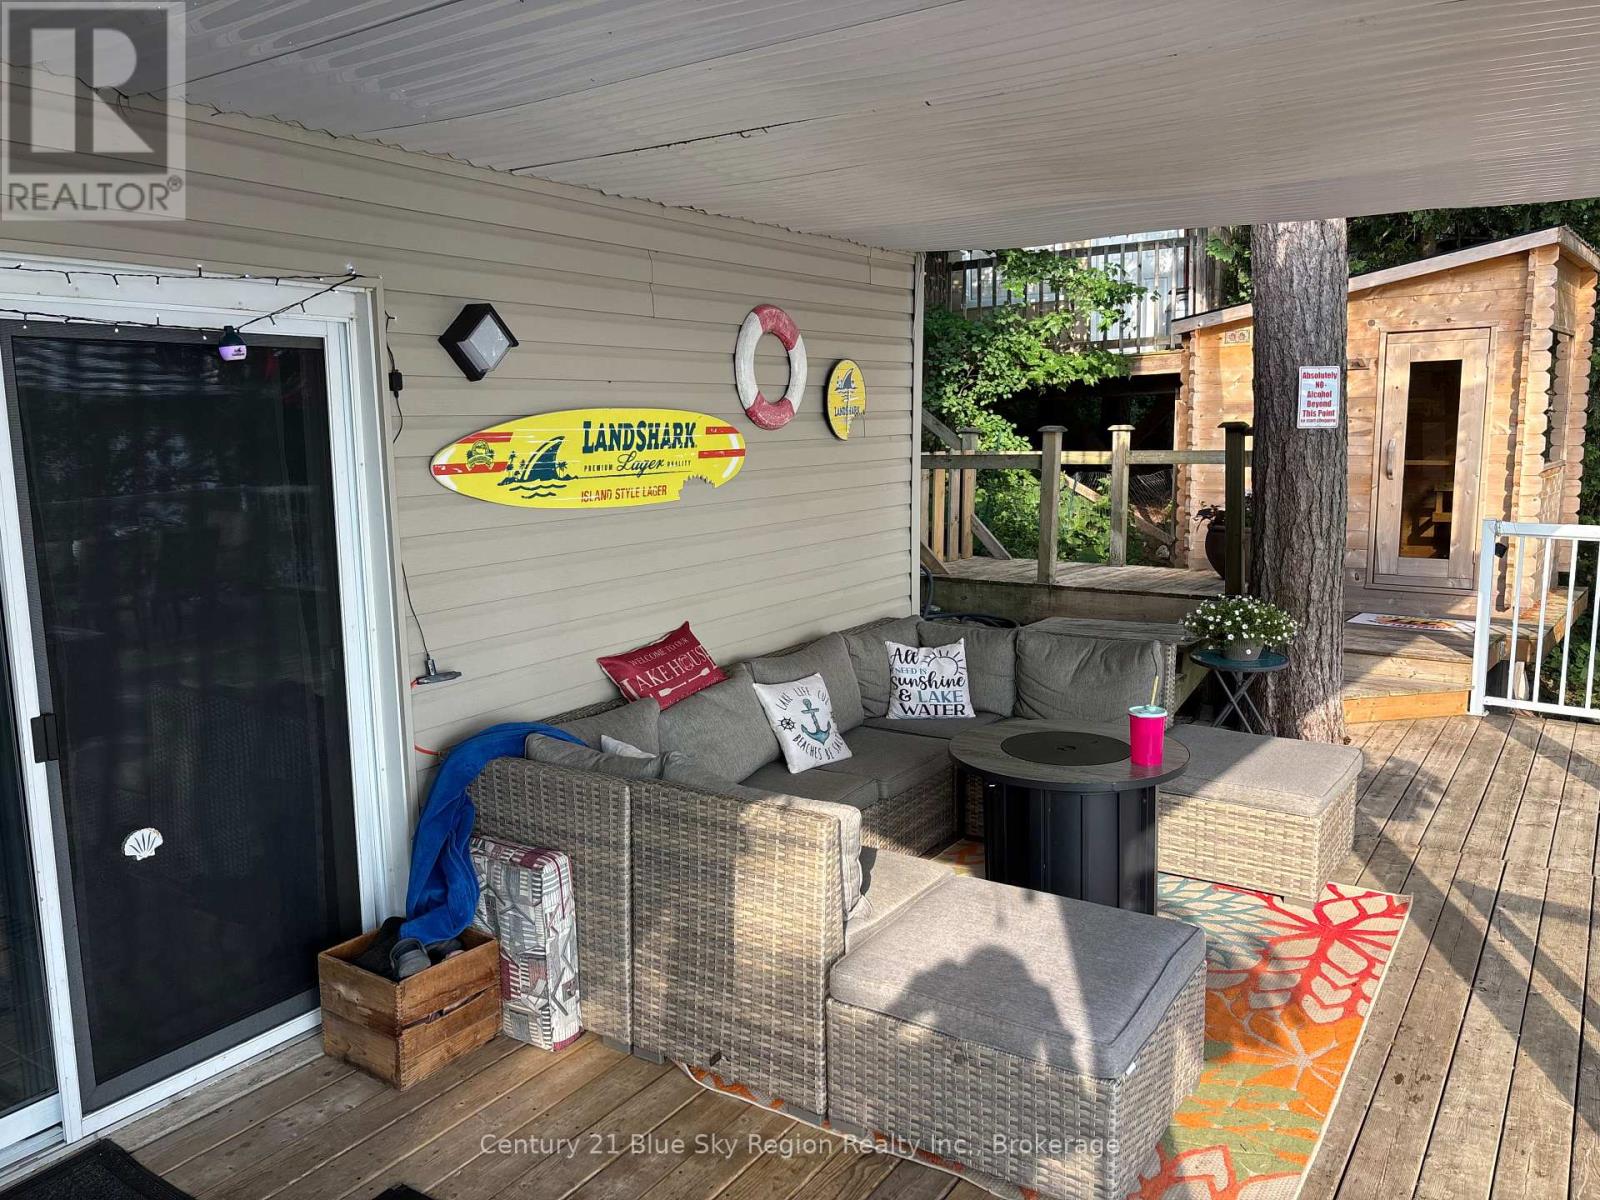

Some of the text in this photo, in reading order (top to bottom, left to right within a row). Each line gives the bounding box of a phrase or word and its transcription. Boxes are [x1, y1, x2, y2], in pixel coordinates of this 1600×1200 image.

[1307, 400, 1332, 408] Beyond
[584, 463, 613, 472] PREMIUM
[617, 450, 665, 478] Lager
[581, 484, 667, 502] ISLAND STYLE LAGER
[628, 648, 667, 666] WELCOME
[890, 647, 919, 666] All
[895, 667, 917, 675] NEED
[776, 692, 793, 711] LAKE
[793, 686, 810, 697] LIFE
[899, 688, 963, 703] & LAKE
[900, 703, 965, 716] WATER
[793, 734, 823, 760] BEACHES
[825, 748, 834, 760] BE
